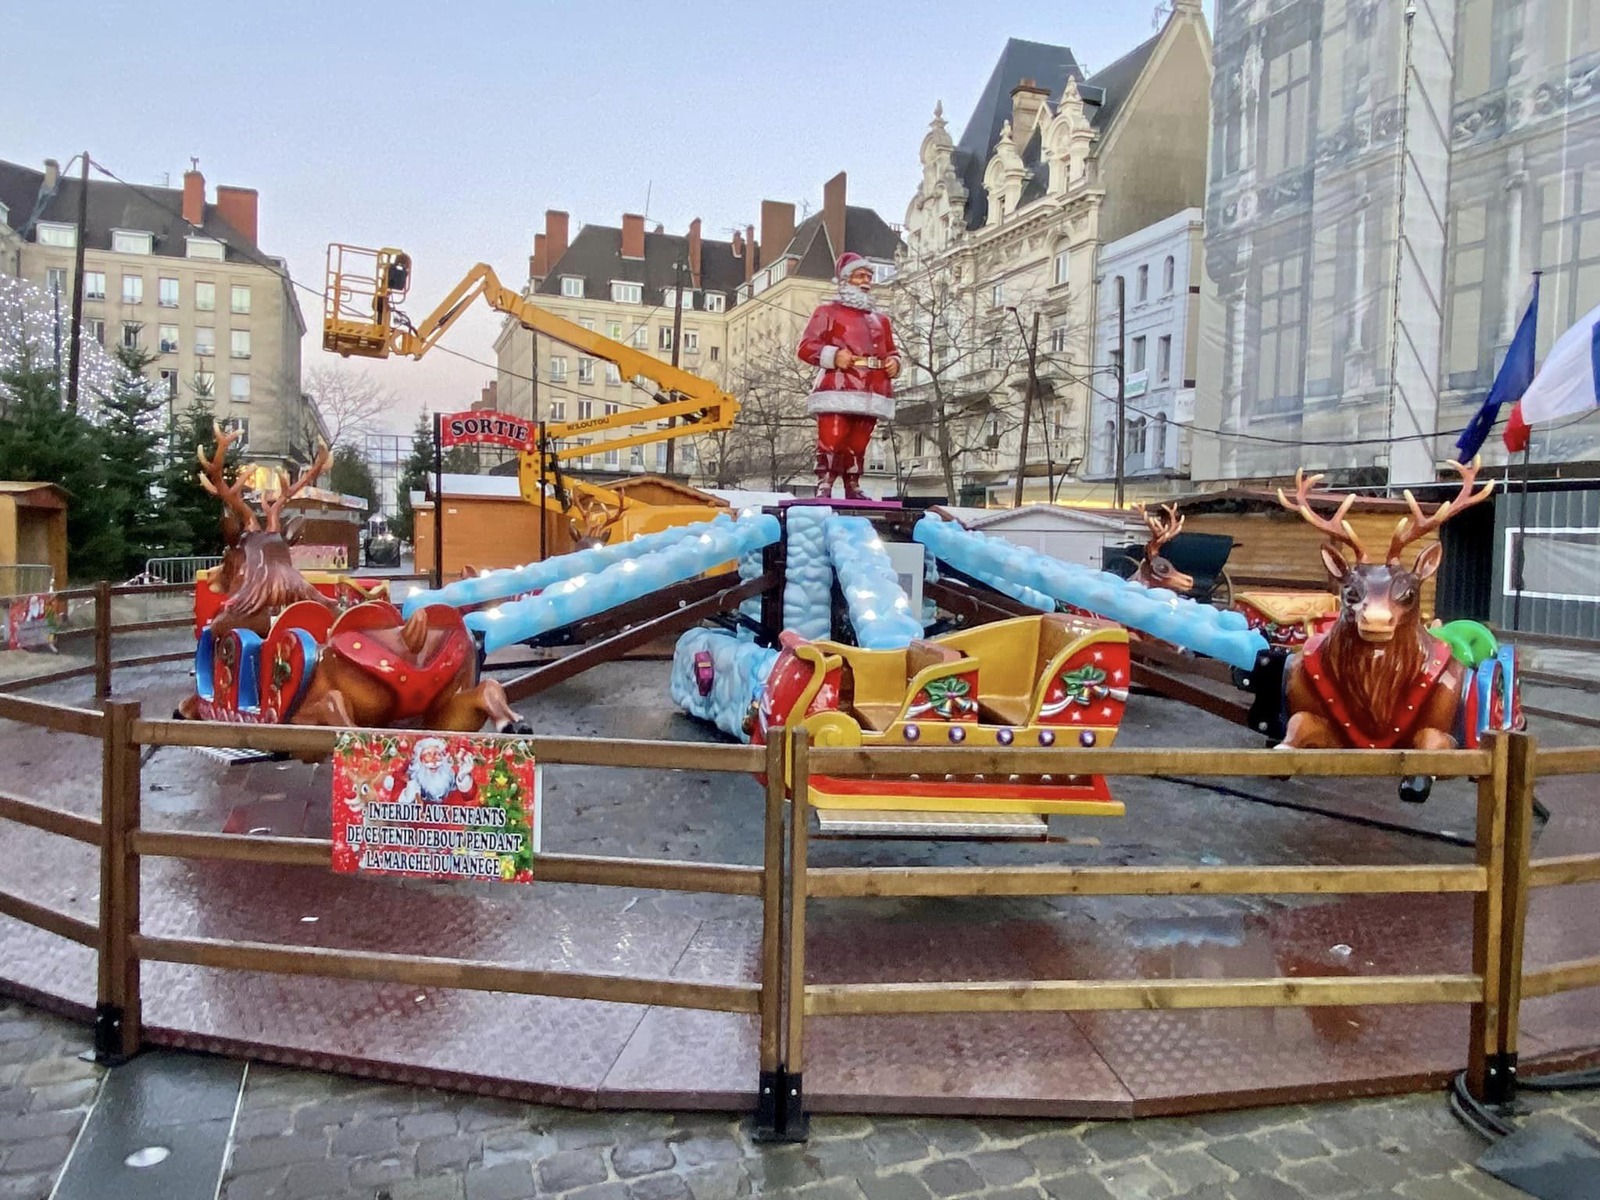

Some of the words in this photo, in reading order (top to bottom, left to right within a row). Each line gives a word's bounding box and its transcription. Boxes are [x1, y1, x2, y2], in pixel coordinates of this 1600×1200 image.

[451, 418, 529, 441] SORTIE
[368, 802, 422, 821] INTERDIT
[425, 806, 450, 823] AUX
[452, 807, 506, 825] ENFANTS
[347, 826, 362, 842] DE
[365, 827, 378, 843] CE
[381, 828, 416, 846] TENIR
[418, 830, 463, 848] DEBOUT
[466, 833, 521, 851] PENDANT
[366, 851, 381, 867] LA
[382, 853, 431, 871] MARCHE
[432, 855, 449, 871] DU
[451, 856, 500, 875] MANEGE
